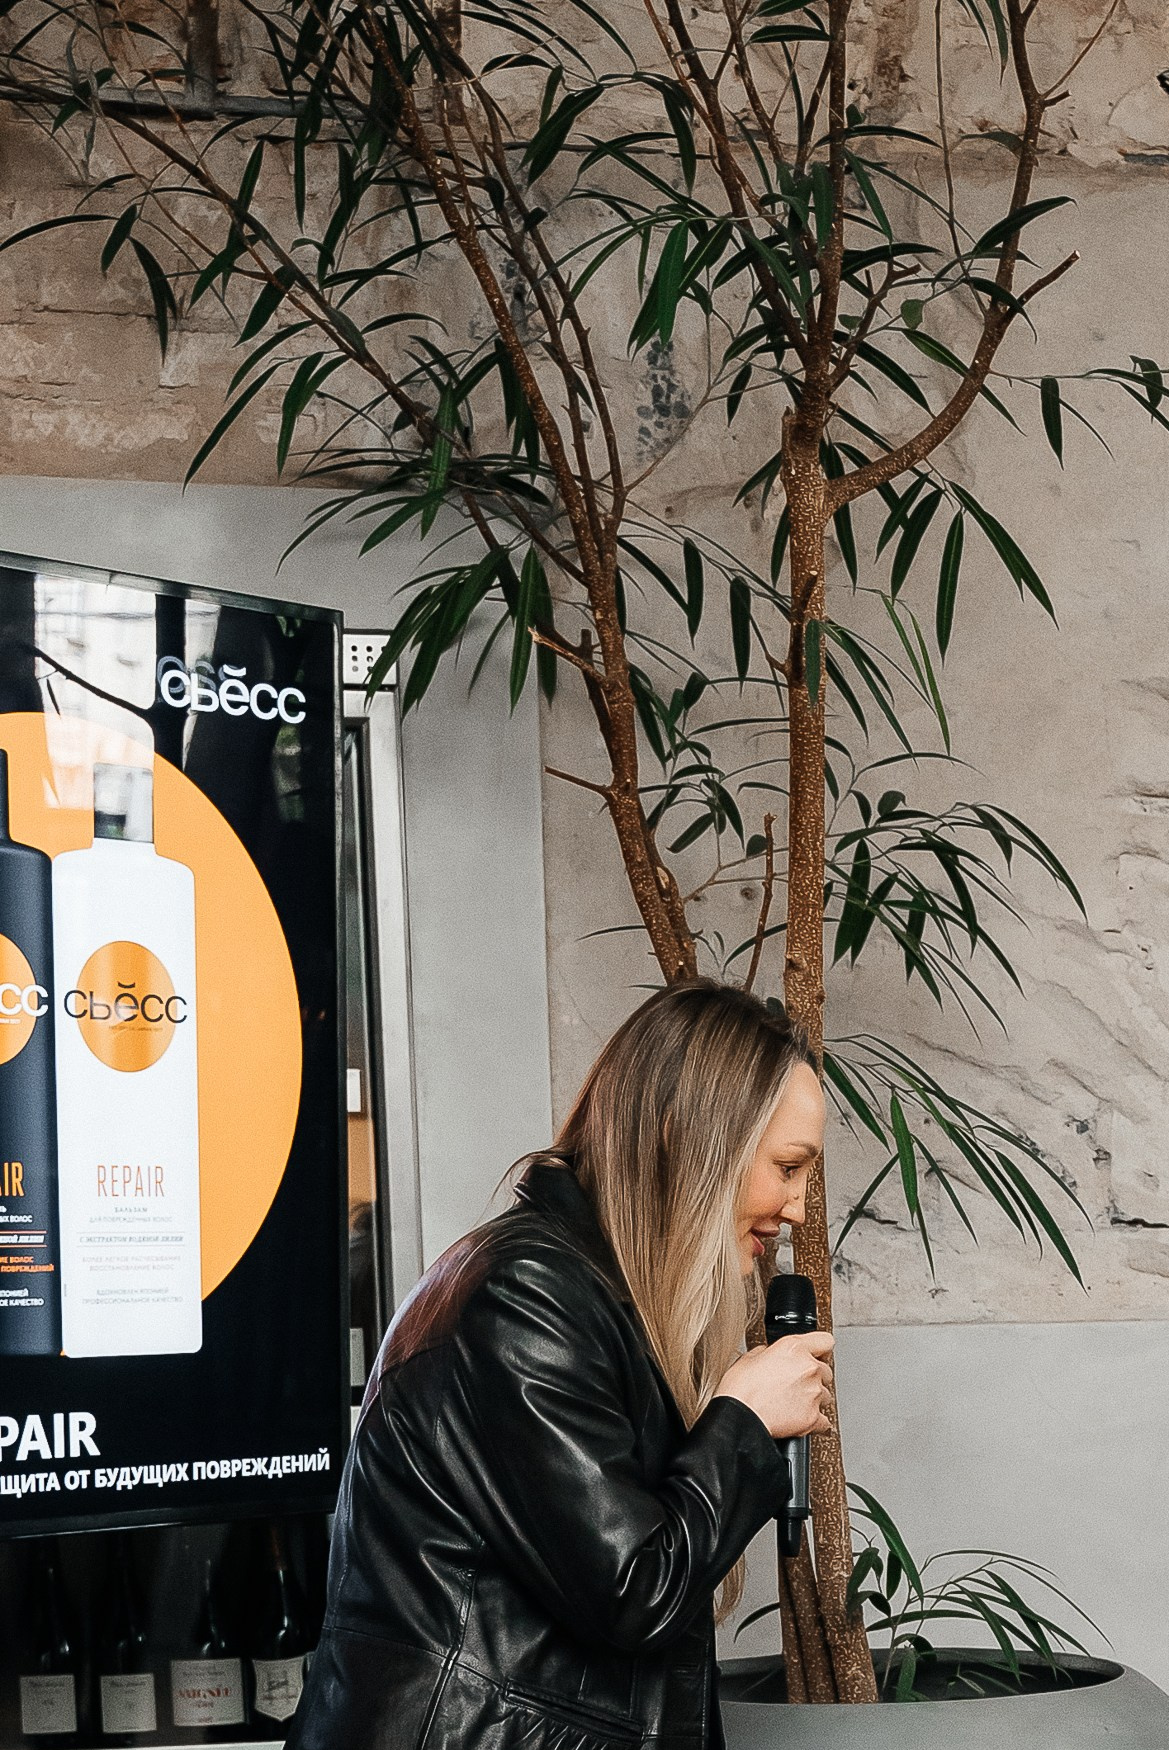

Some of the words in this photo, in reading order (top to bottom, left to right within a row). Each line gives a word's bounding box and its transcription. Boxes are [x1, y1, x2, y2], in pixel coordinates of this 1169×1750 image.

[97, 1165, 165, 1197] REPAIR
[64, 1470, 91, 1491] ОТ
[95, 1462, 190, 1490] БУДУЩИХ
[192, 1447, 331, 1481] ПОВРЕЖДЕНИЙ
